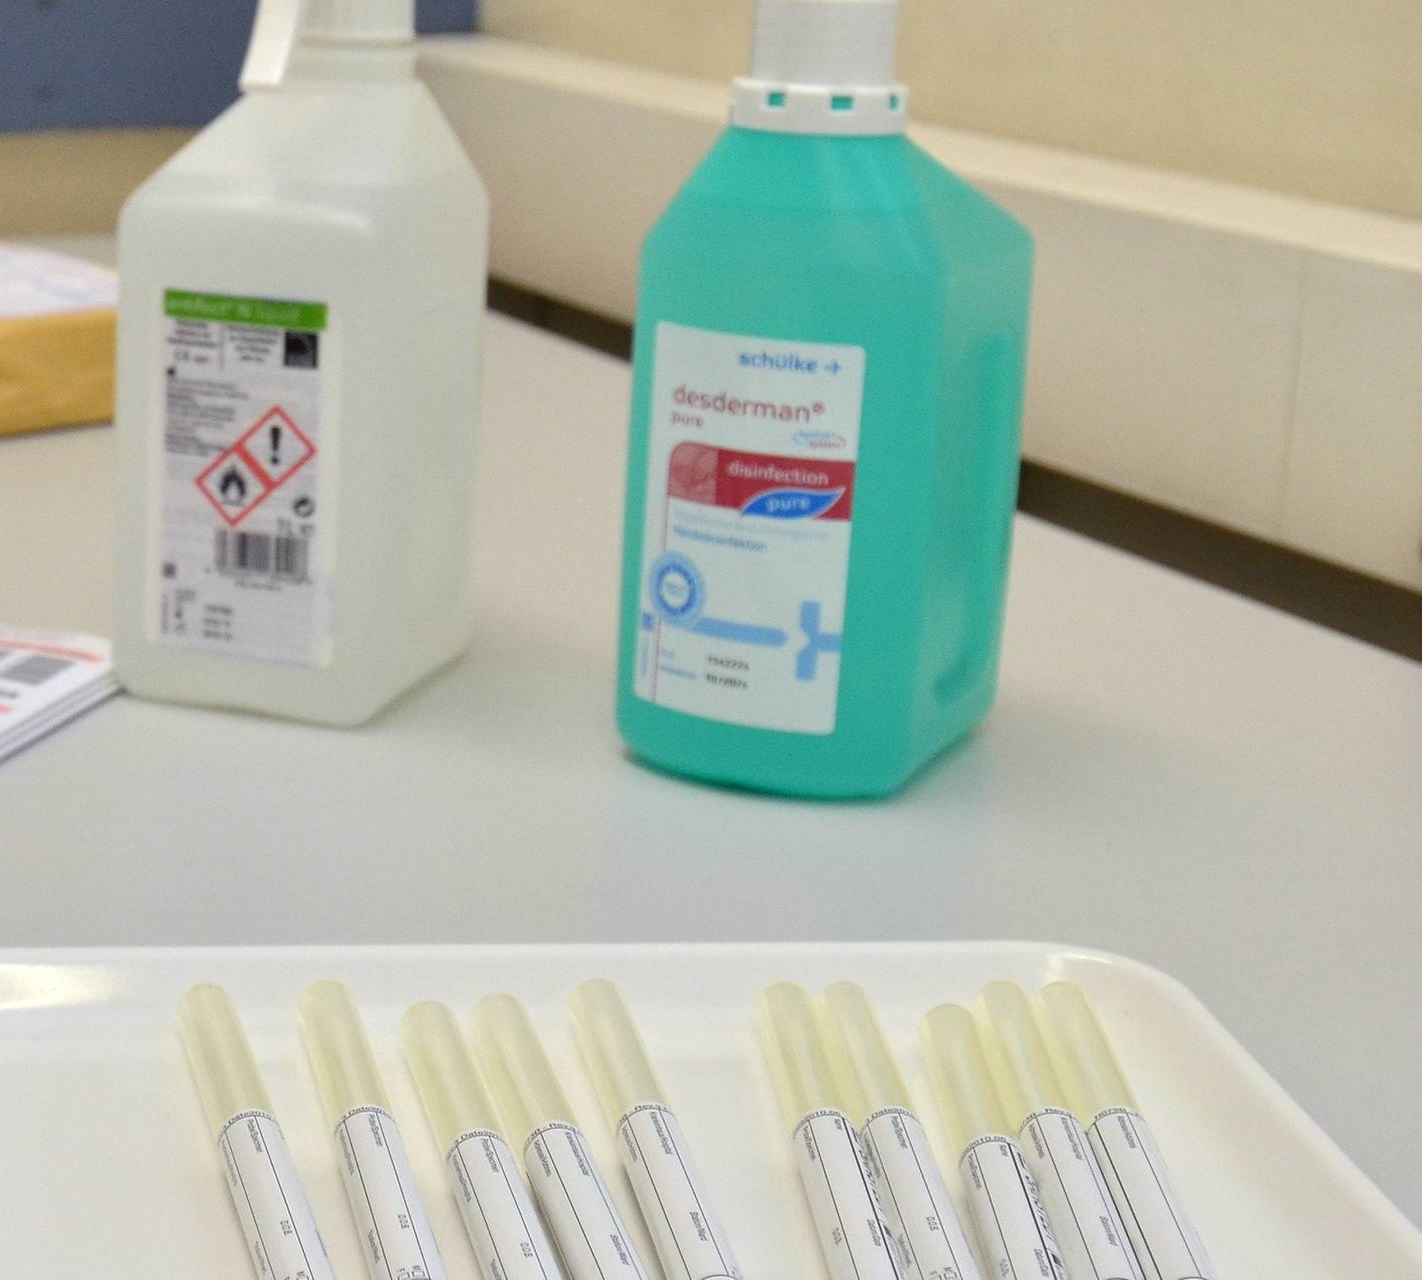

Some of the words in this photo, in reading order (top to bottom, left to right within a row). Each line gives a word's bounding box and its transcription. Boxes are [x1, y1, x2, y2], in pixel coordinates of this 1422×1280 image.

[738, 352, 818, 374] schülke
[671, 410, 704, 428] pure
[728, 460, 829, 485] disinfection
[765, 497, 811, 514] pure
